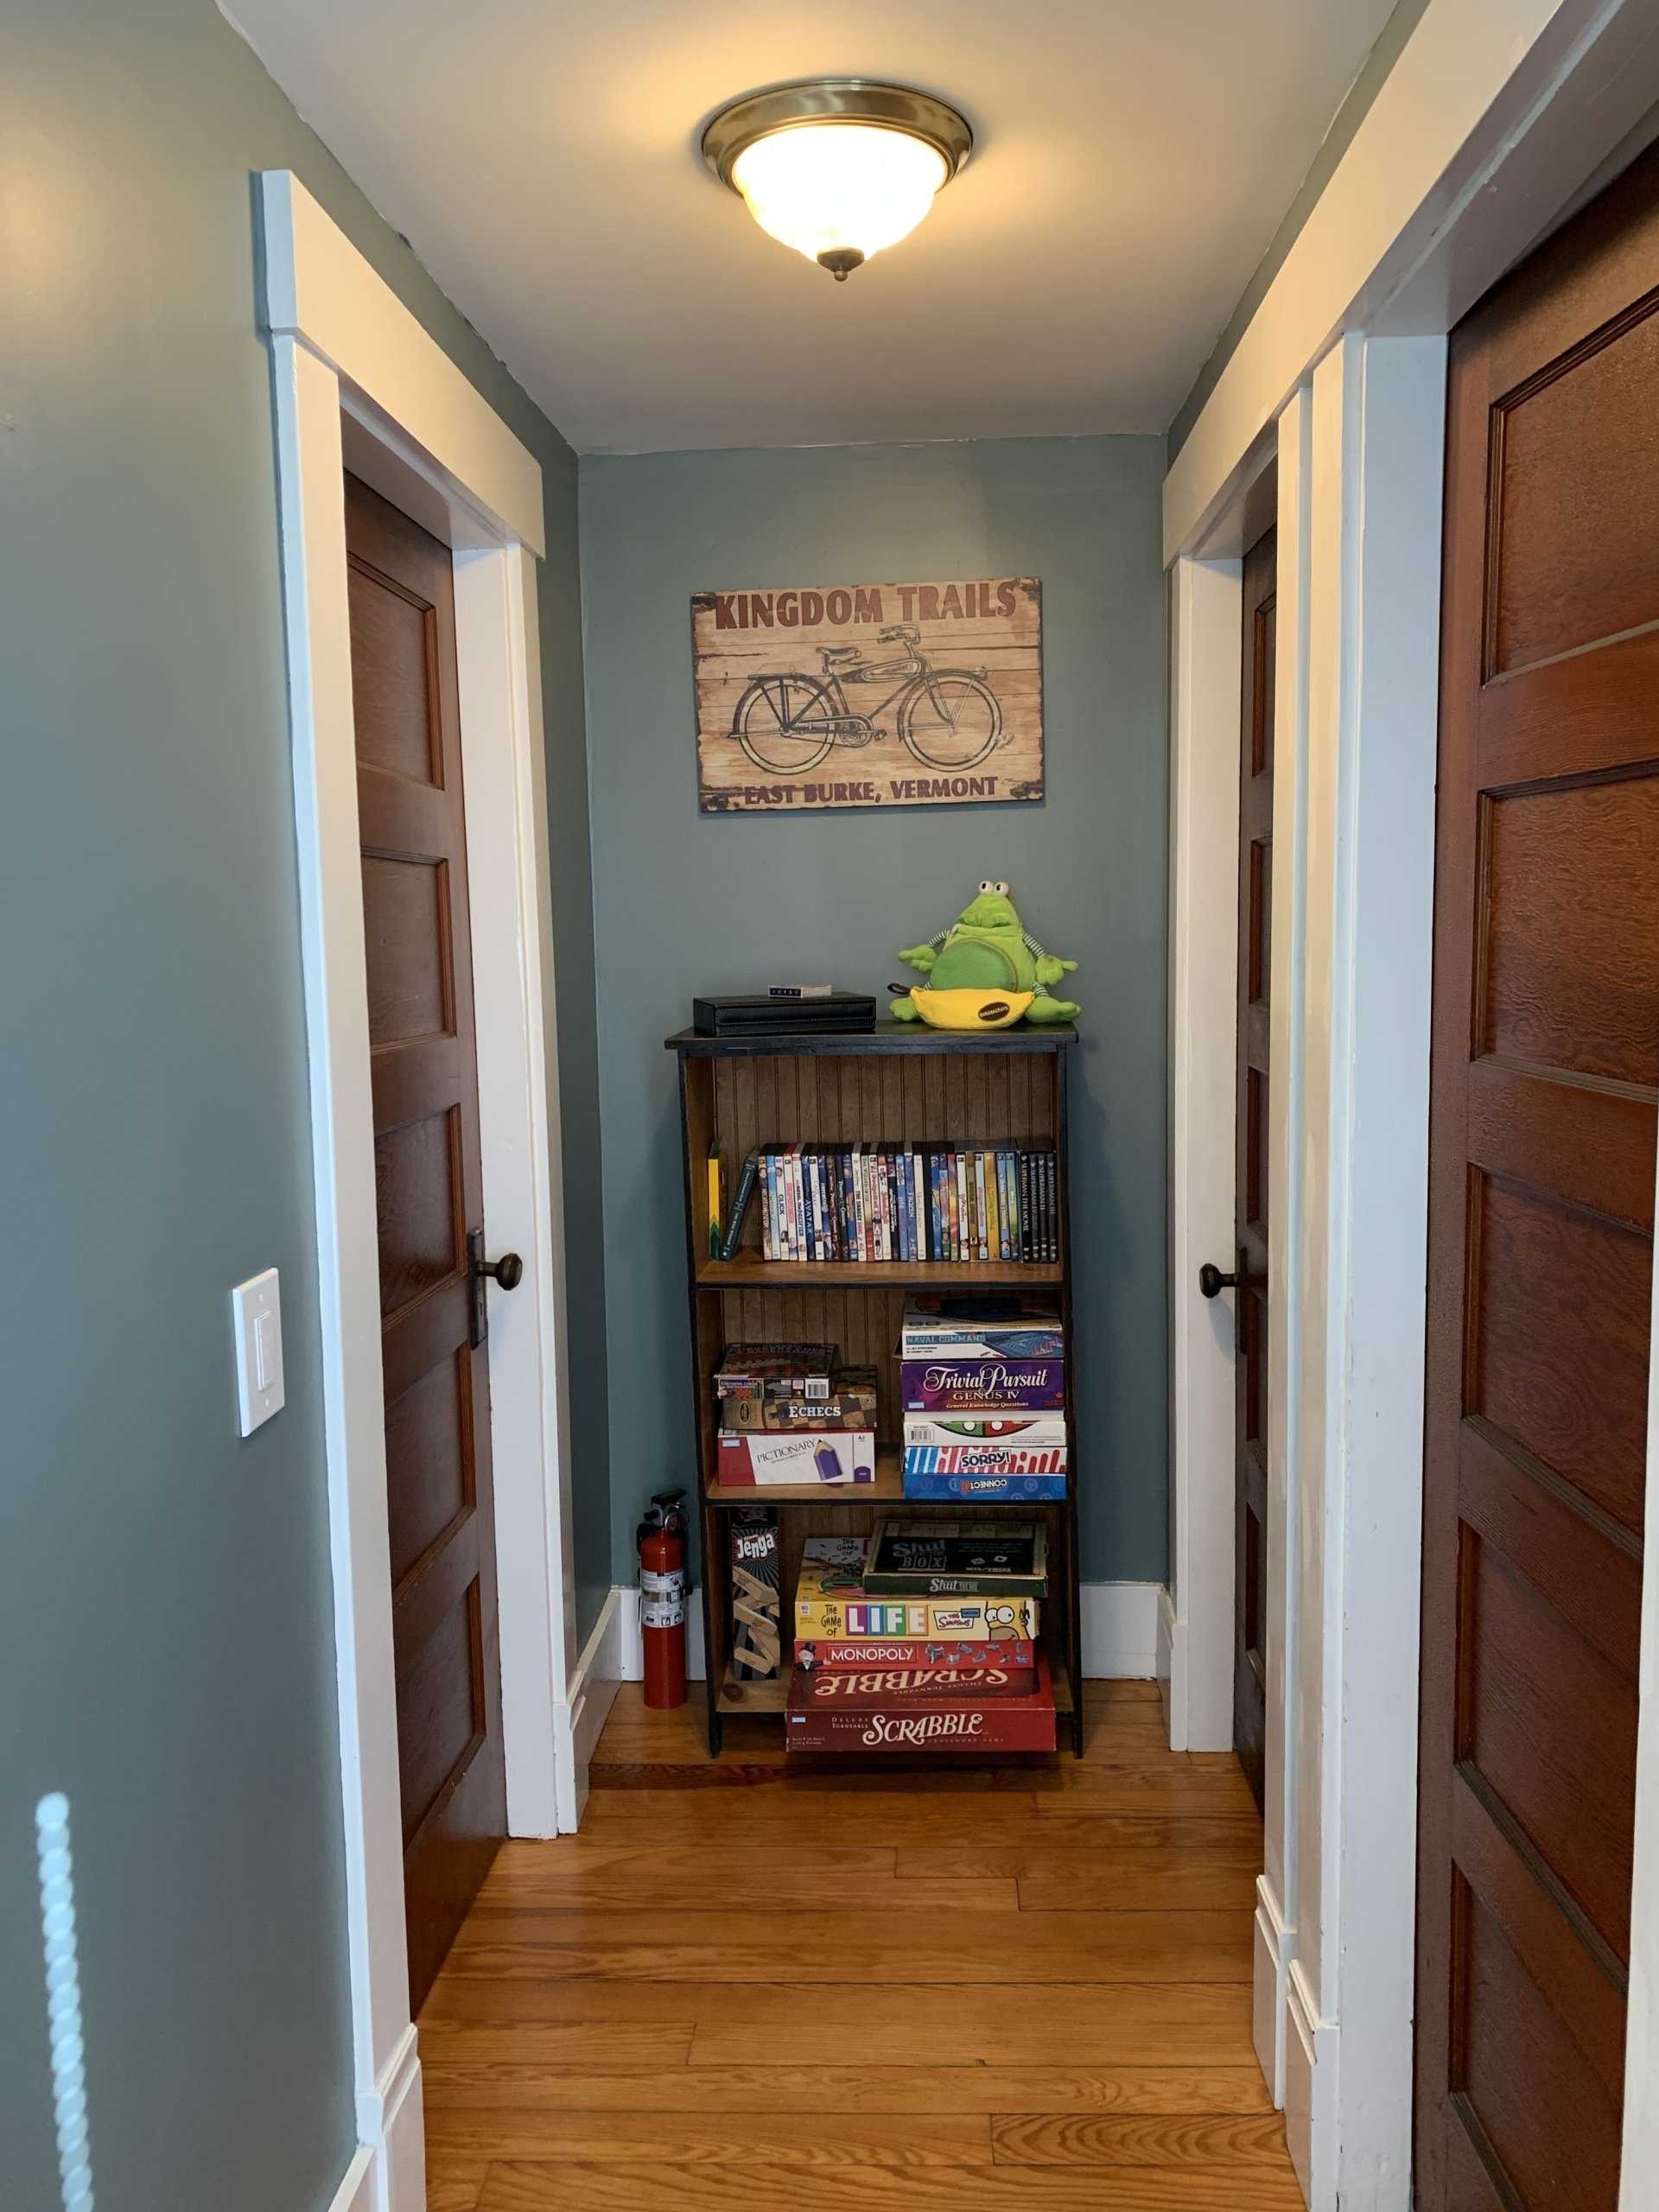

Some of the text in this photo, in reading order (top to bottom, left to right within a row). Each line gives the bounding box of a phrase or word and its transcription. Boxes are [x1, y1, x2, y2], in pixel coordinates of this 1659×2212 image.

[715, 582, 1017, 630] KINGDOM TRAILS
[744, 776, 999, 805] EAST BURKE, VERMONT
[804, 1199, 813, 1235] AVATAR
[906, 1334, 986, 1344] NAVAL COMMAND
[923, 1363, 1048, 1395] Trivial Pursuit
[1007, 1389, 1020, 1400] IV
[788, 1402, 842, 1418] ÉCHECS
[756, 1438, 816, 1463] PICTIONARY
[961, 1451, 1012, 1467] SORRY!
[969, 1478, 1007, 1490] CONNECT
[736, 1534, 775, 1559] Jenga
[892, 1539, 947, 1558] Shut
[902, 1555, 943, 1568] BOX
[929, 1577, 959, 1592] Shut
[848, 1606, 928, 1634] LIFE
[830, 1648, 914, 1662] MONOPOLY
[862, 1713, 984, 1745] SCRABBLE
